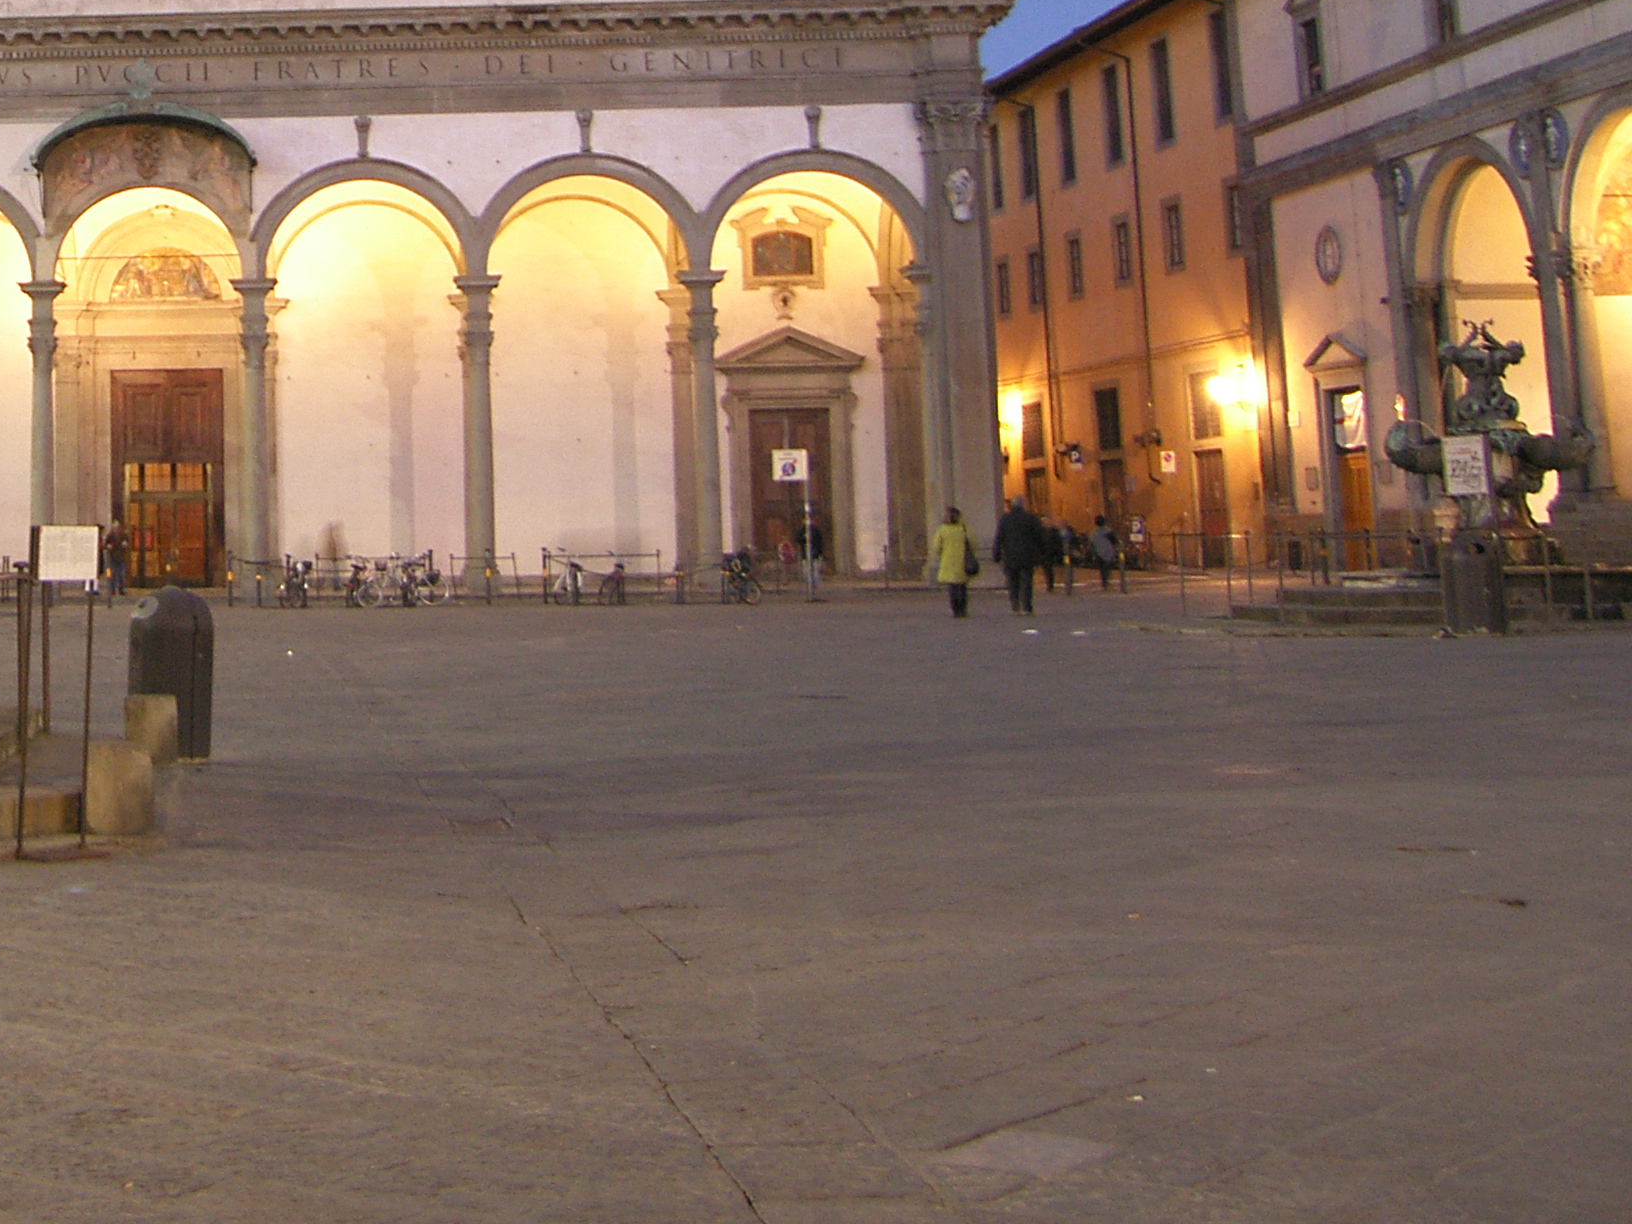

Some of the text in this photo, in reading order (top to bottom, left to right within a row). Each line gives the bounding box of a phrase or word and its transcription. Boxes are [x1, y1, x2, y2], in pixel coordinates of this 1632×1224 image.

[75, 62, 209, 85] PVCCII
[253, 57, 430, 81] FRATRES
[484, 54, 555, 76] DEI
[609, 47, 841, 73] GENITRICI
